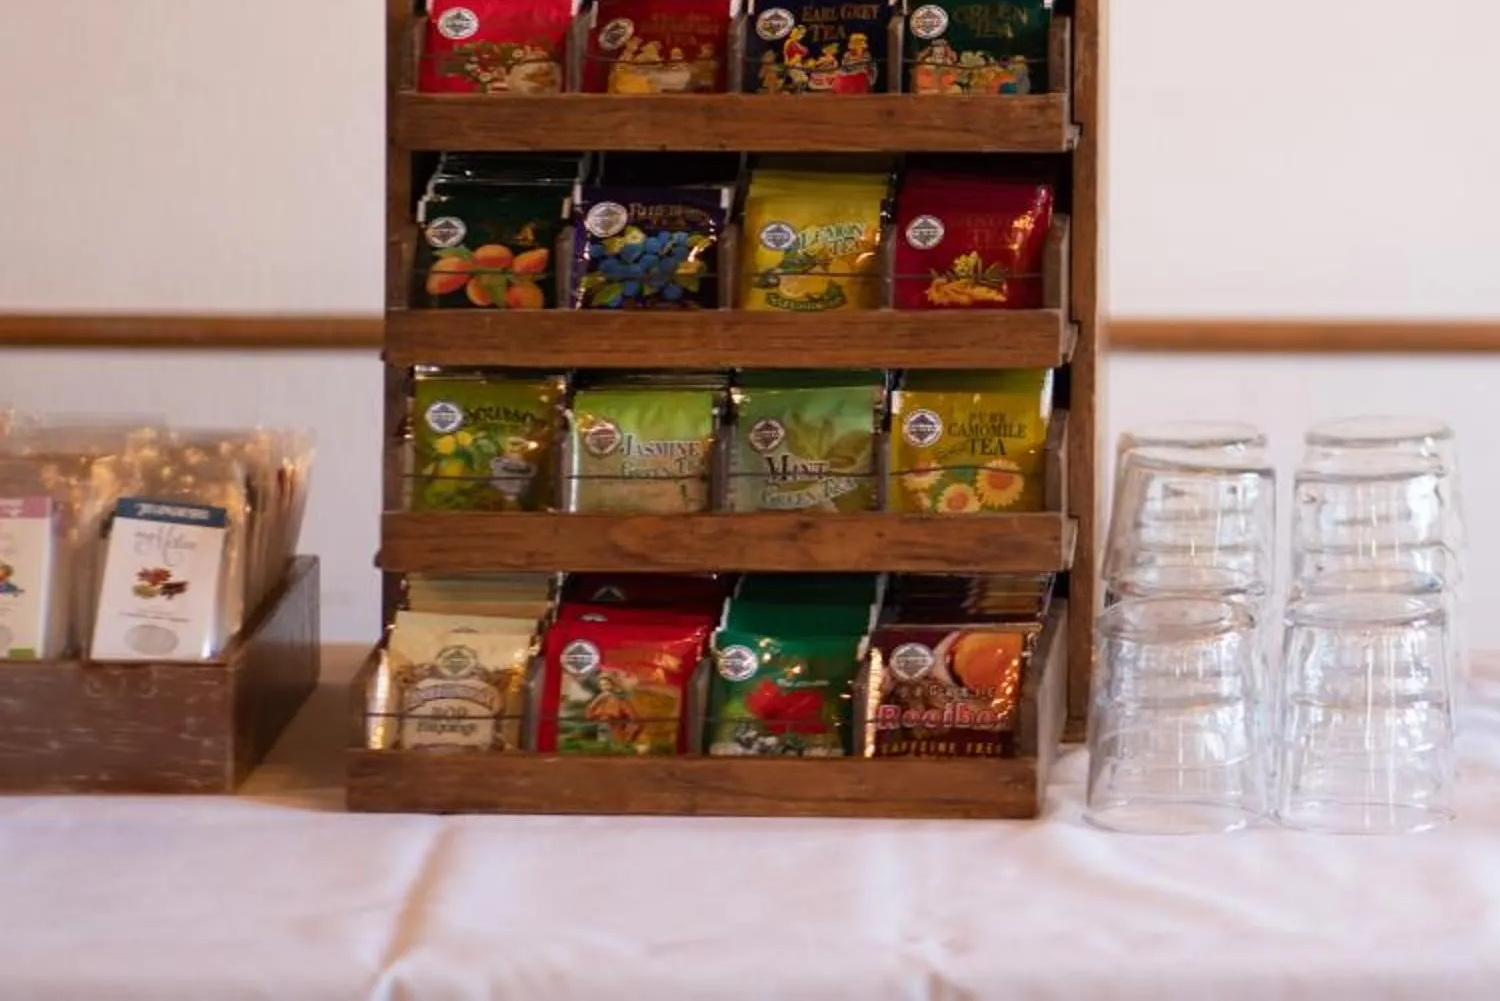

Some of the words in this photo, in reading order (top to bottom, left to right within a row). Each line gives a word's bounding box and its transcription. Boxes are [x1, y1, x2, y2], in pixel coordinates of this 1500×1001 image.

[801, 6, 837, 22] EARL
[809, 24, 846, 41] TEA
[948, 422, 1027, 439] CAMOMILE
[619, 434, 701, 456] JASMINE
[969, 438, 1007, 456] TEA
[765, 454, 829, 481] MINT
